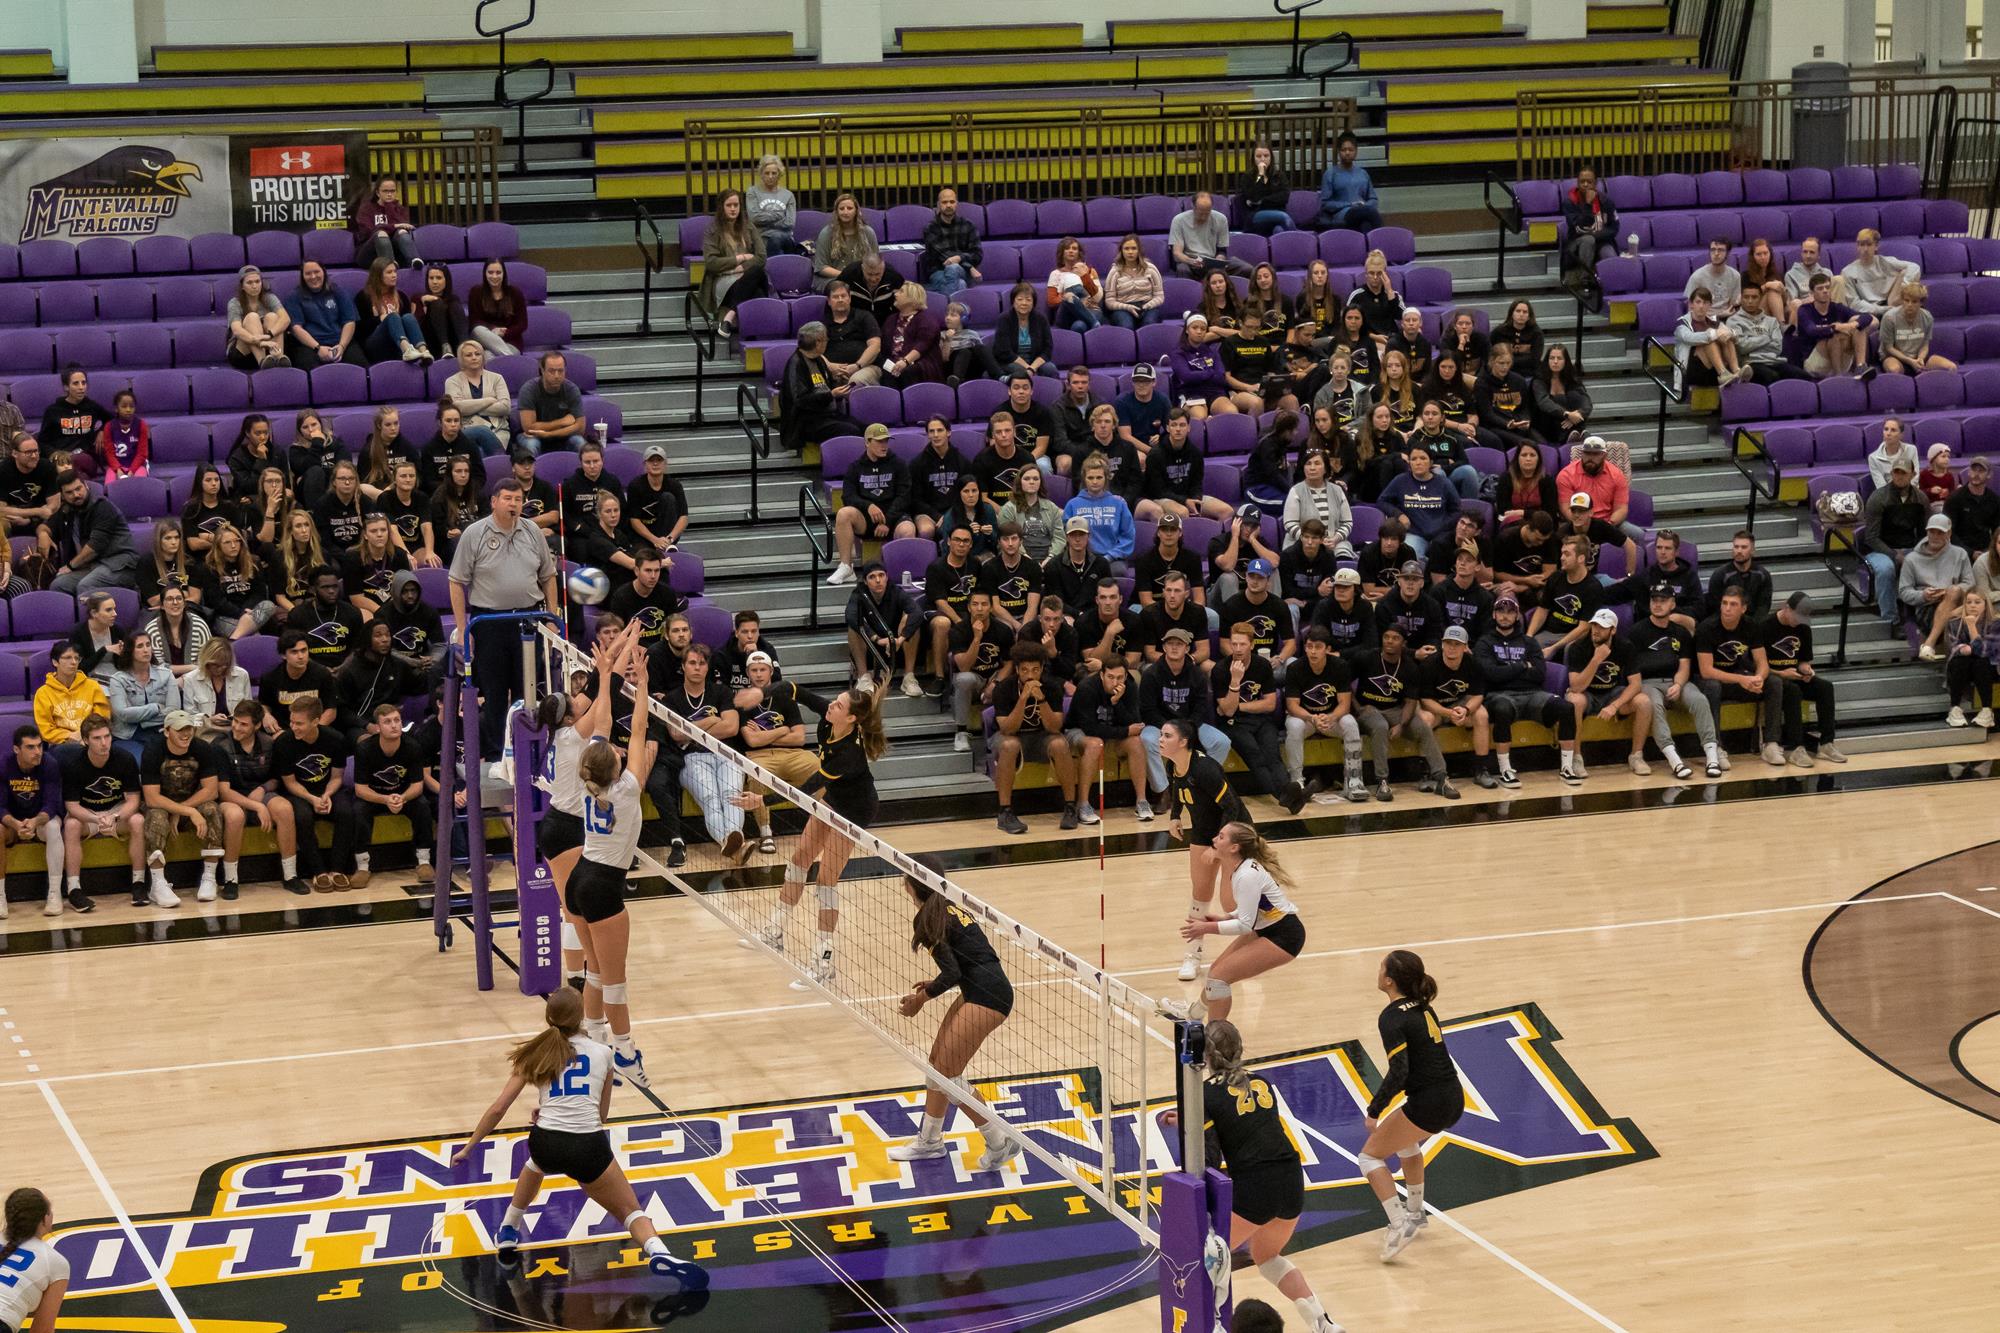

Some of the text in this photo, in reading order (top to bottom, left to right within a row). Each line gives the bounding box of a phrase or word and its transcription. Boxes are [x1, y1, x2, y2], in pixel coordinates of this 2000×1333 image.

[67, 187, 135, 195] UNIVERSITY
[250, 175, 346, 202] PROTECT
[23, 188, 176, 239] MONTEVALLO
[73, 216, 155, 233] FALCONS
[252, 201, 351, 223] THIS HOUSE.
[536, 915, 551, 967] senoh
[1424, 1010, 1443, 1044] 4
[549, 1054, 591, 1098] 12
[1227, 1079, 1274, 1116] 23
[233, 1079, 1077, 1211] FALCNS
